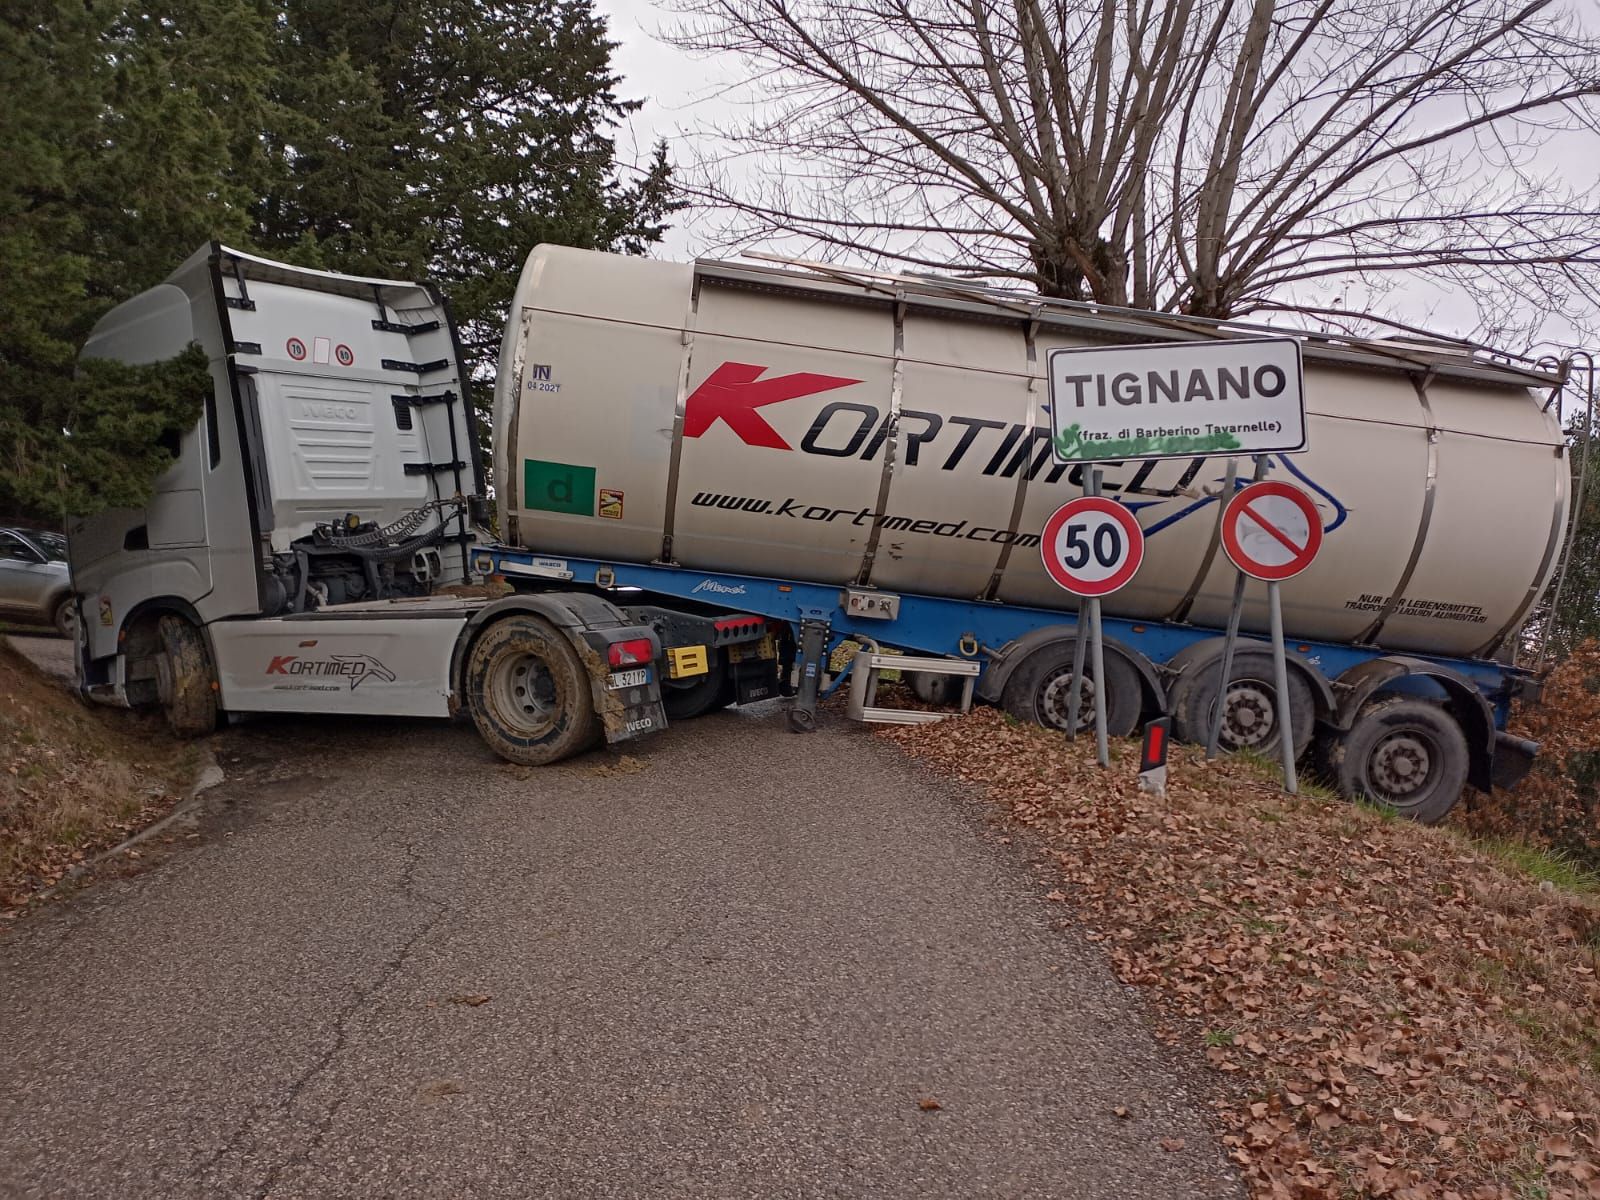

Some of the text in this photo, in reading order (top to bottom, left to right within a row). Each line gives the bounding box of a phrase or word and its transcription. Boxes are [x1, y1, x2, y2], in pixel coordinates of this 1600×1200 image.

[291, 344, 302, 355] 70
[340, 350, 350, 361] 80
[533, 366, 551, 380] IN
[1065, 364, 1287, 408] TIGNANO
[1118, 428, 1130, 440] di
[1136, 425, 1200, 439] Barberino
[1205, 420, 1282, 436] Tavarnelle)
[547, 472, 574, 503] d
[691, 491, 1041, 548] www.kortimed.com
[1064, 522, 1121, 569] 50
[1358, 594, 1483, 616] NUR FR LEBENSMITTEL
[1399, 606, 1432, 618] LIQUIDI
[1432, 611, 1488, 624] ALIMENTARI
[265, 655, 366, 675] KORTIMED
[622, 670, 646, 686] 321YP
[750, 686, 768, 698] IVECO
[626, 717, 651, 732] IVECO
